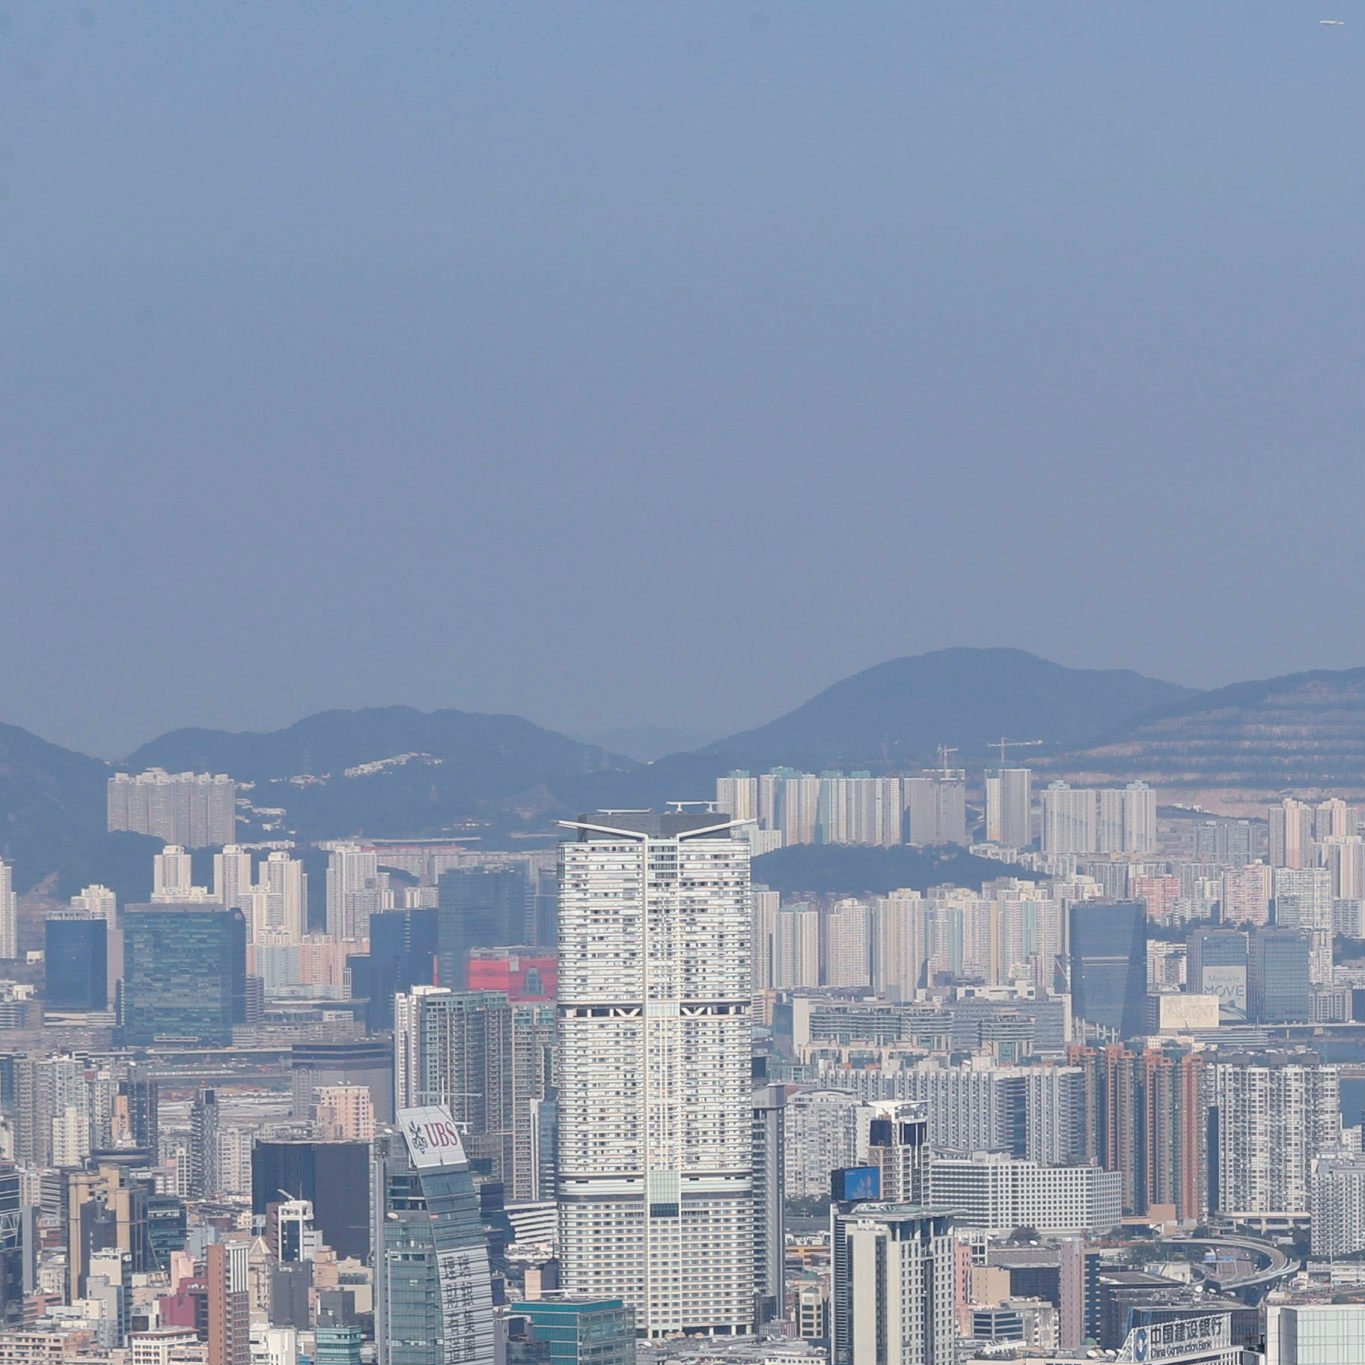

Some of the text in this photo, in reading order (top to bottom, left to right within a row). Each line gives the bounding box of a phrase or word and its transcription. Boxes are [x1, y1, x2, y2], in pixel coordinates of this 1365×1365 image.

[1204, 985, 1244, 997] MOVE
[424, 1121, 458, 1148] UBS
[1150, 1317, 1223, 1344] 中国建设银行
[1150, 1347, 1166, 1358] China
